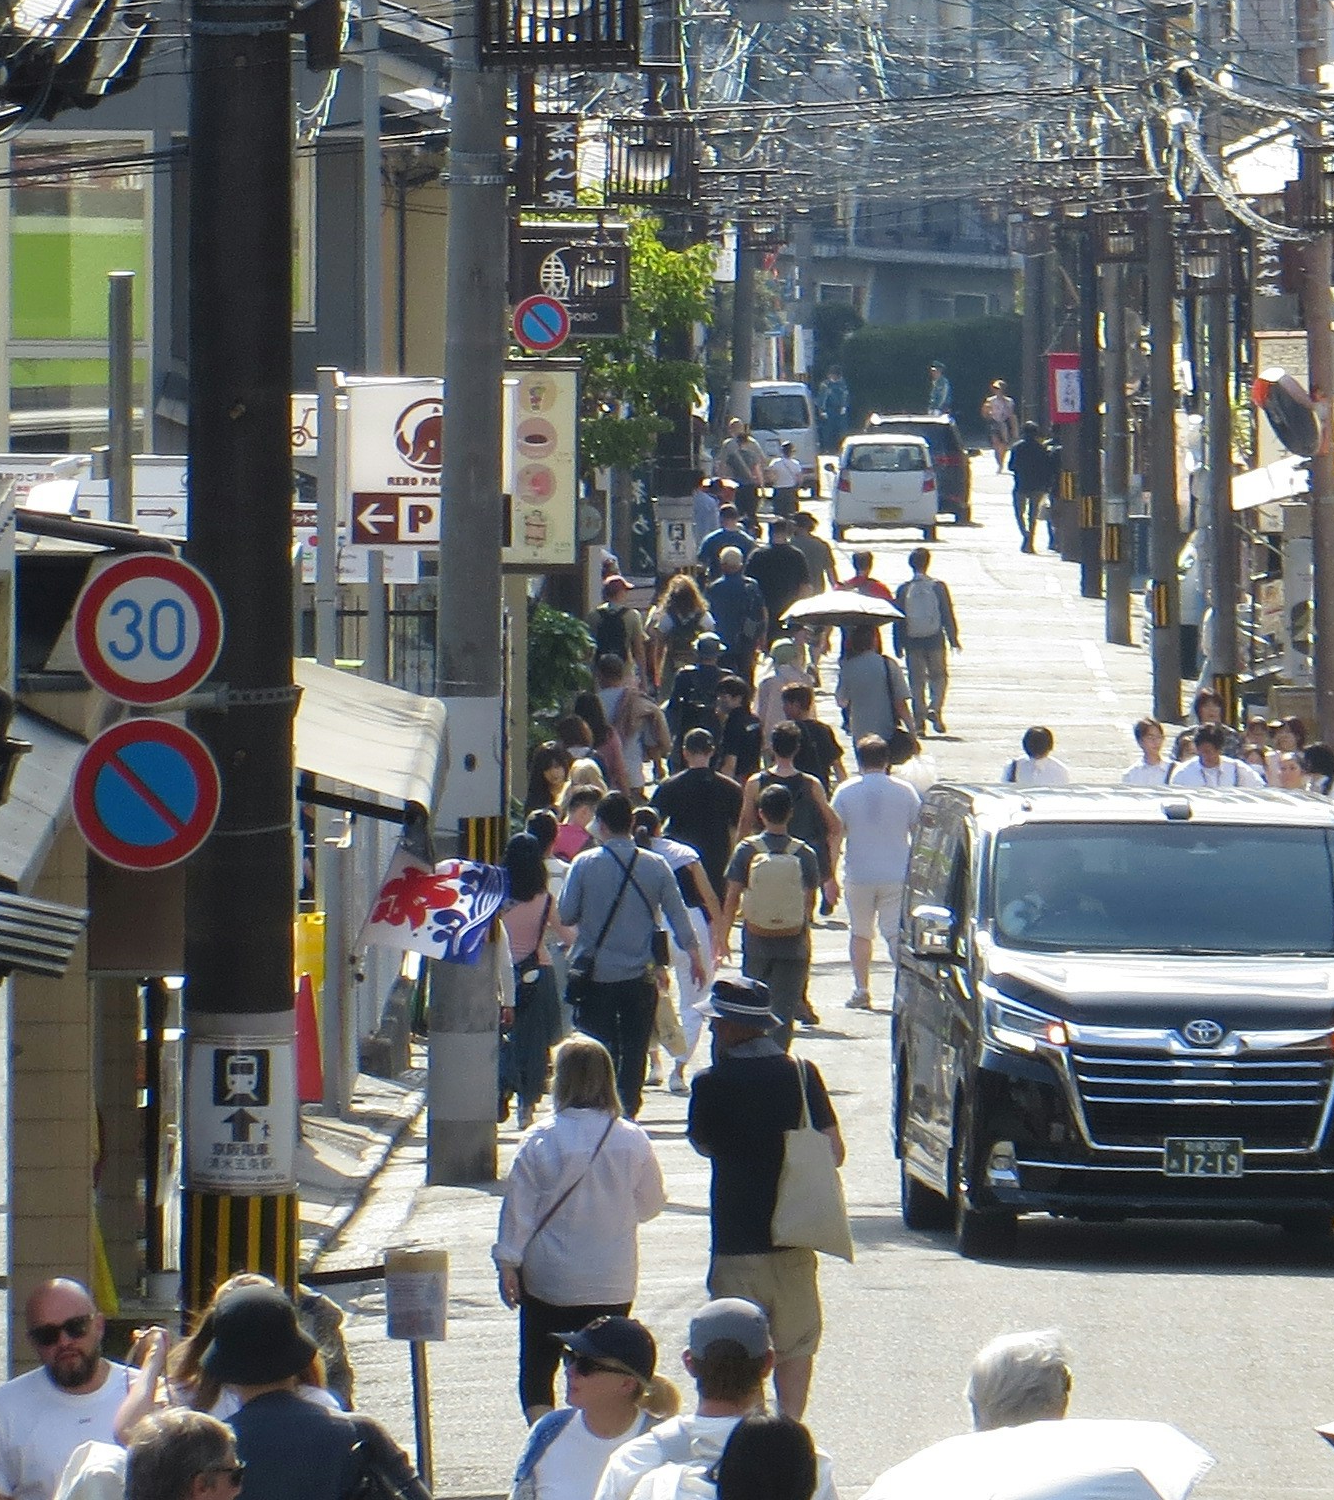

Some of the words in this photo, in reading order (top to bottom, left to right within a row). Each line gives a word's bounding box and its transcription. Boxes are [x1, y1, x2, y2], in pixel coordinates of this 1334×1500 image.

[542, 122, 577, 208] 茶わん坂
[422, 476, 441, 486] PA
[408, 504, 434, 534] P
[108, 598, 186, 662] 30
[1184, 1154, 1239, 1175] 12-19
